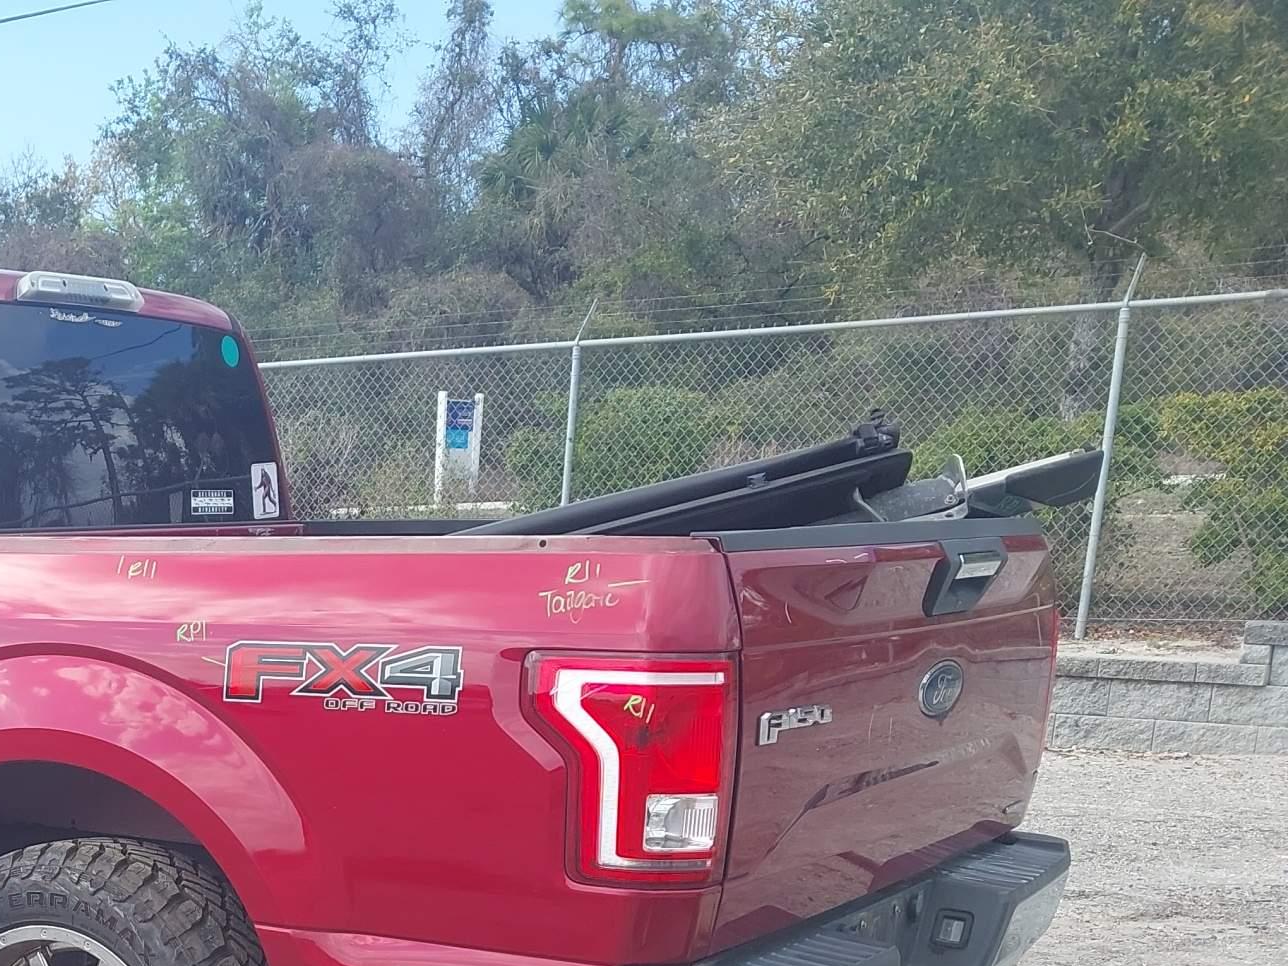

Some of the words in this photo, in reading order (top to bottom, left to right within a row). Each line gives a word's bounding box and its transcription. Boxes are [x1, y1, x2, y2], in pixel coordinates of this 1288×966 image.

[223, 640, 465, 704] FX4
[323, 697, 376, 711] OFF
[384, 700, 458, 715] ROAD
